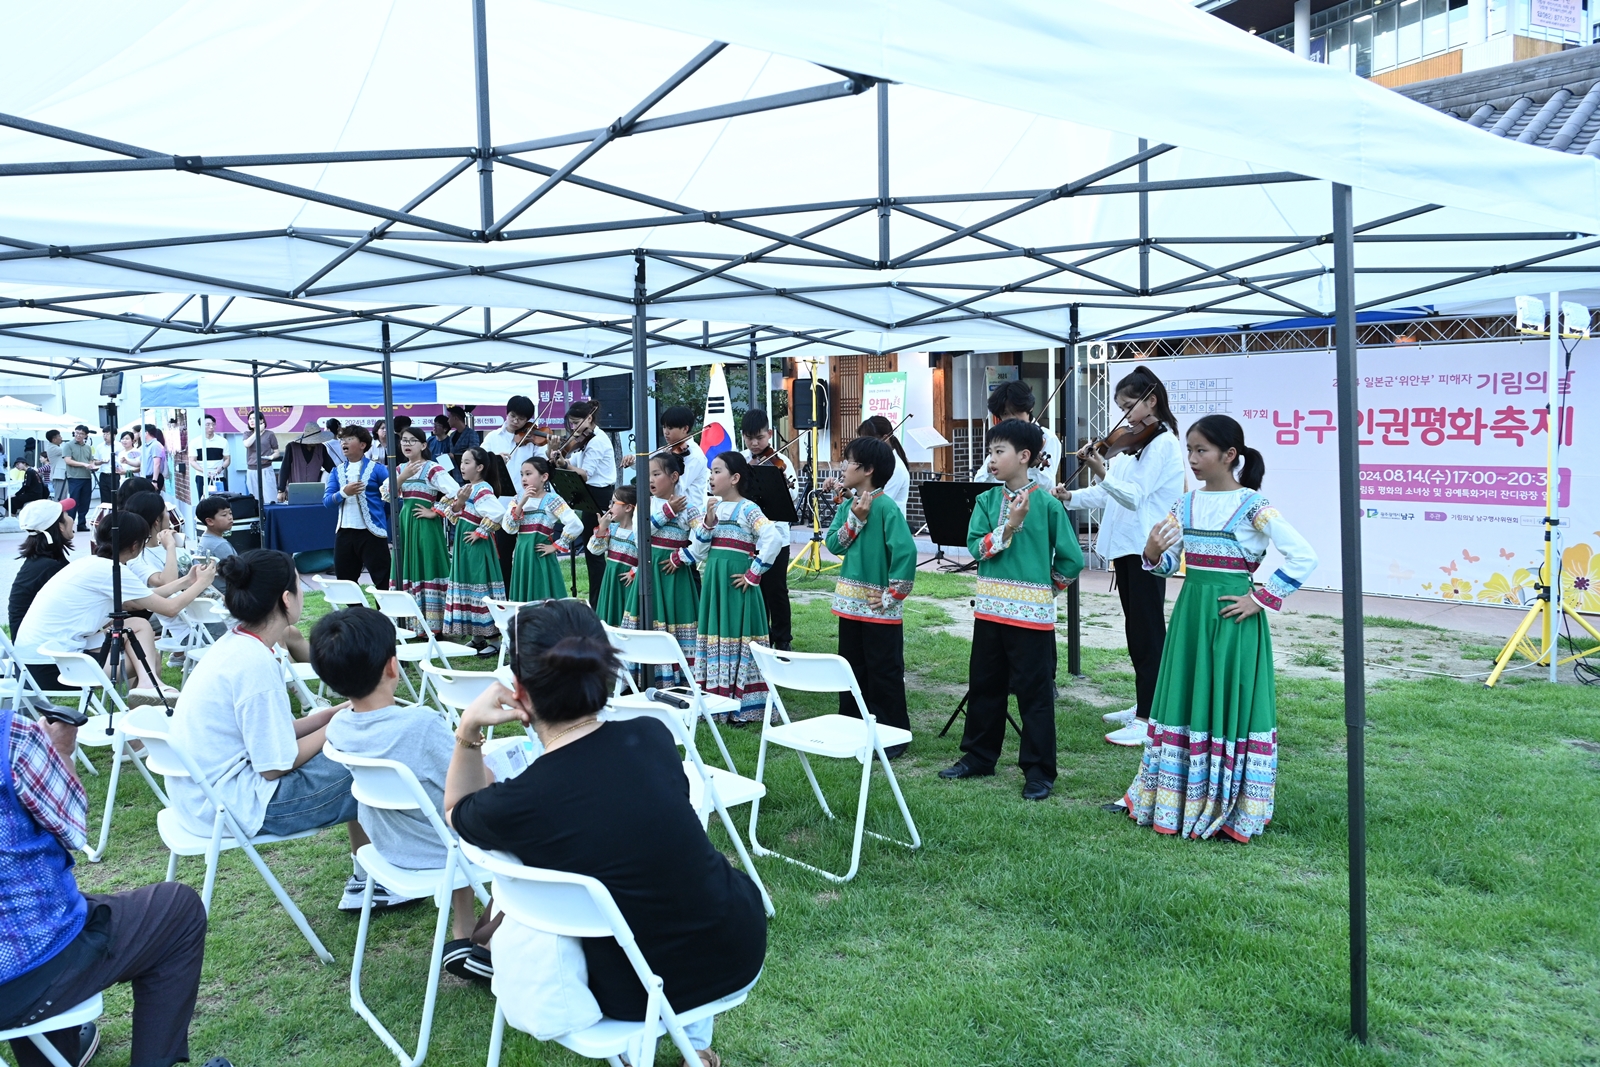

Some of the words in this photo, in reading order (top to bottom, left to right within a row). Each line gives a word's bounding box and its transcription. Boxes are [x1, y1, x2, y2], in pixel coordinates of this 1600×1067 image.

[1438, 373, 1473, 386] 피해자
[868, 398, 891, 411] 양파
[1242, 409, 1269, 420] 제7회
[1272, 408, 1338, 446] 남구
[1360, 485, 1375, 495] 림동
[1377, 486, 1403, 496] 평화의
[1404, 487, 1431, 497] 소녀상
[1432, 488, 1442, 498] 및
[1500, 489, 1539, 501] 잔디광장
[1401, 513, 1415, 521] 남구
